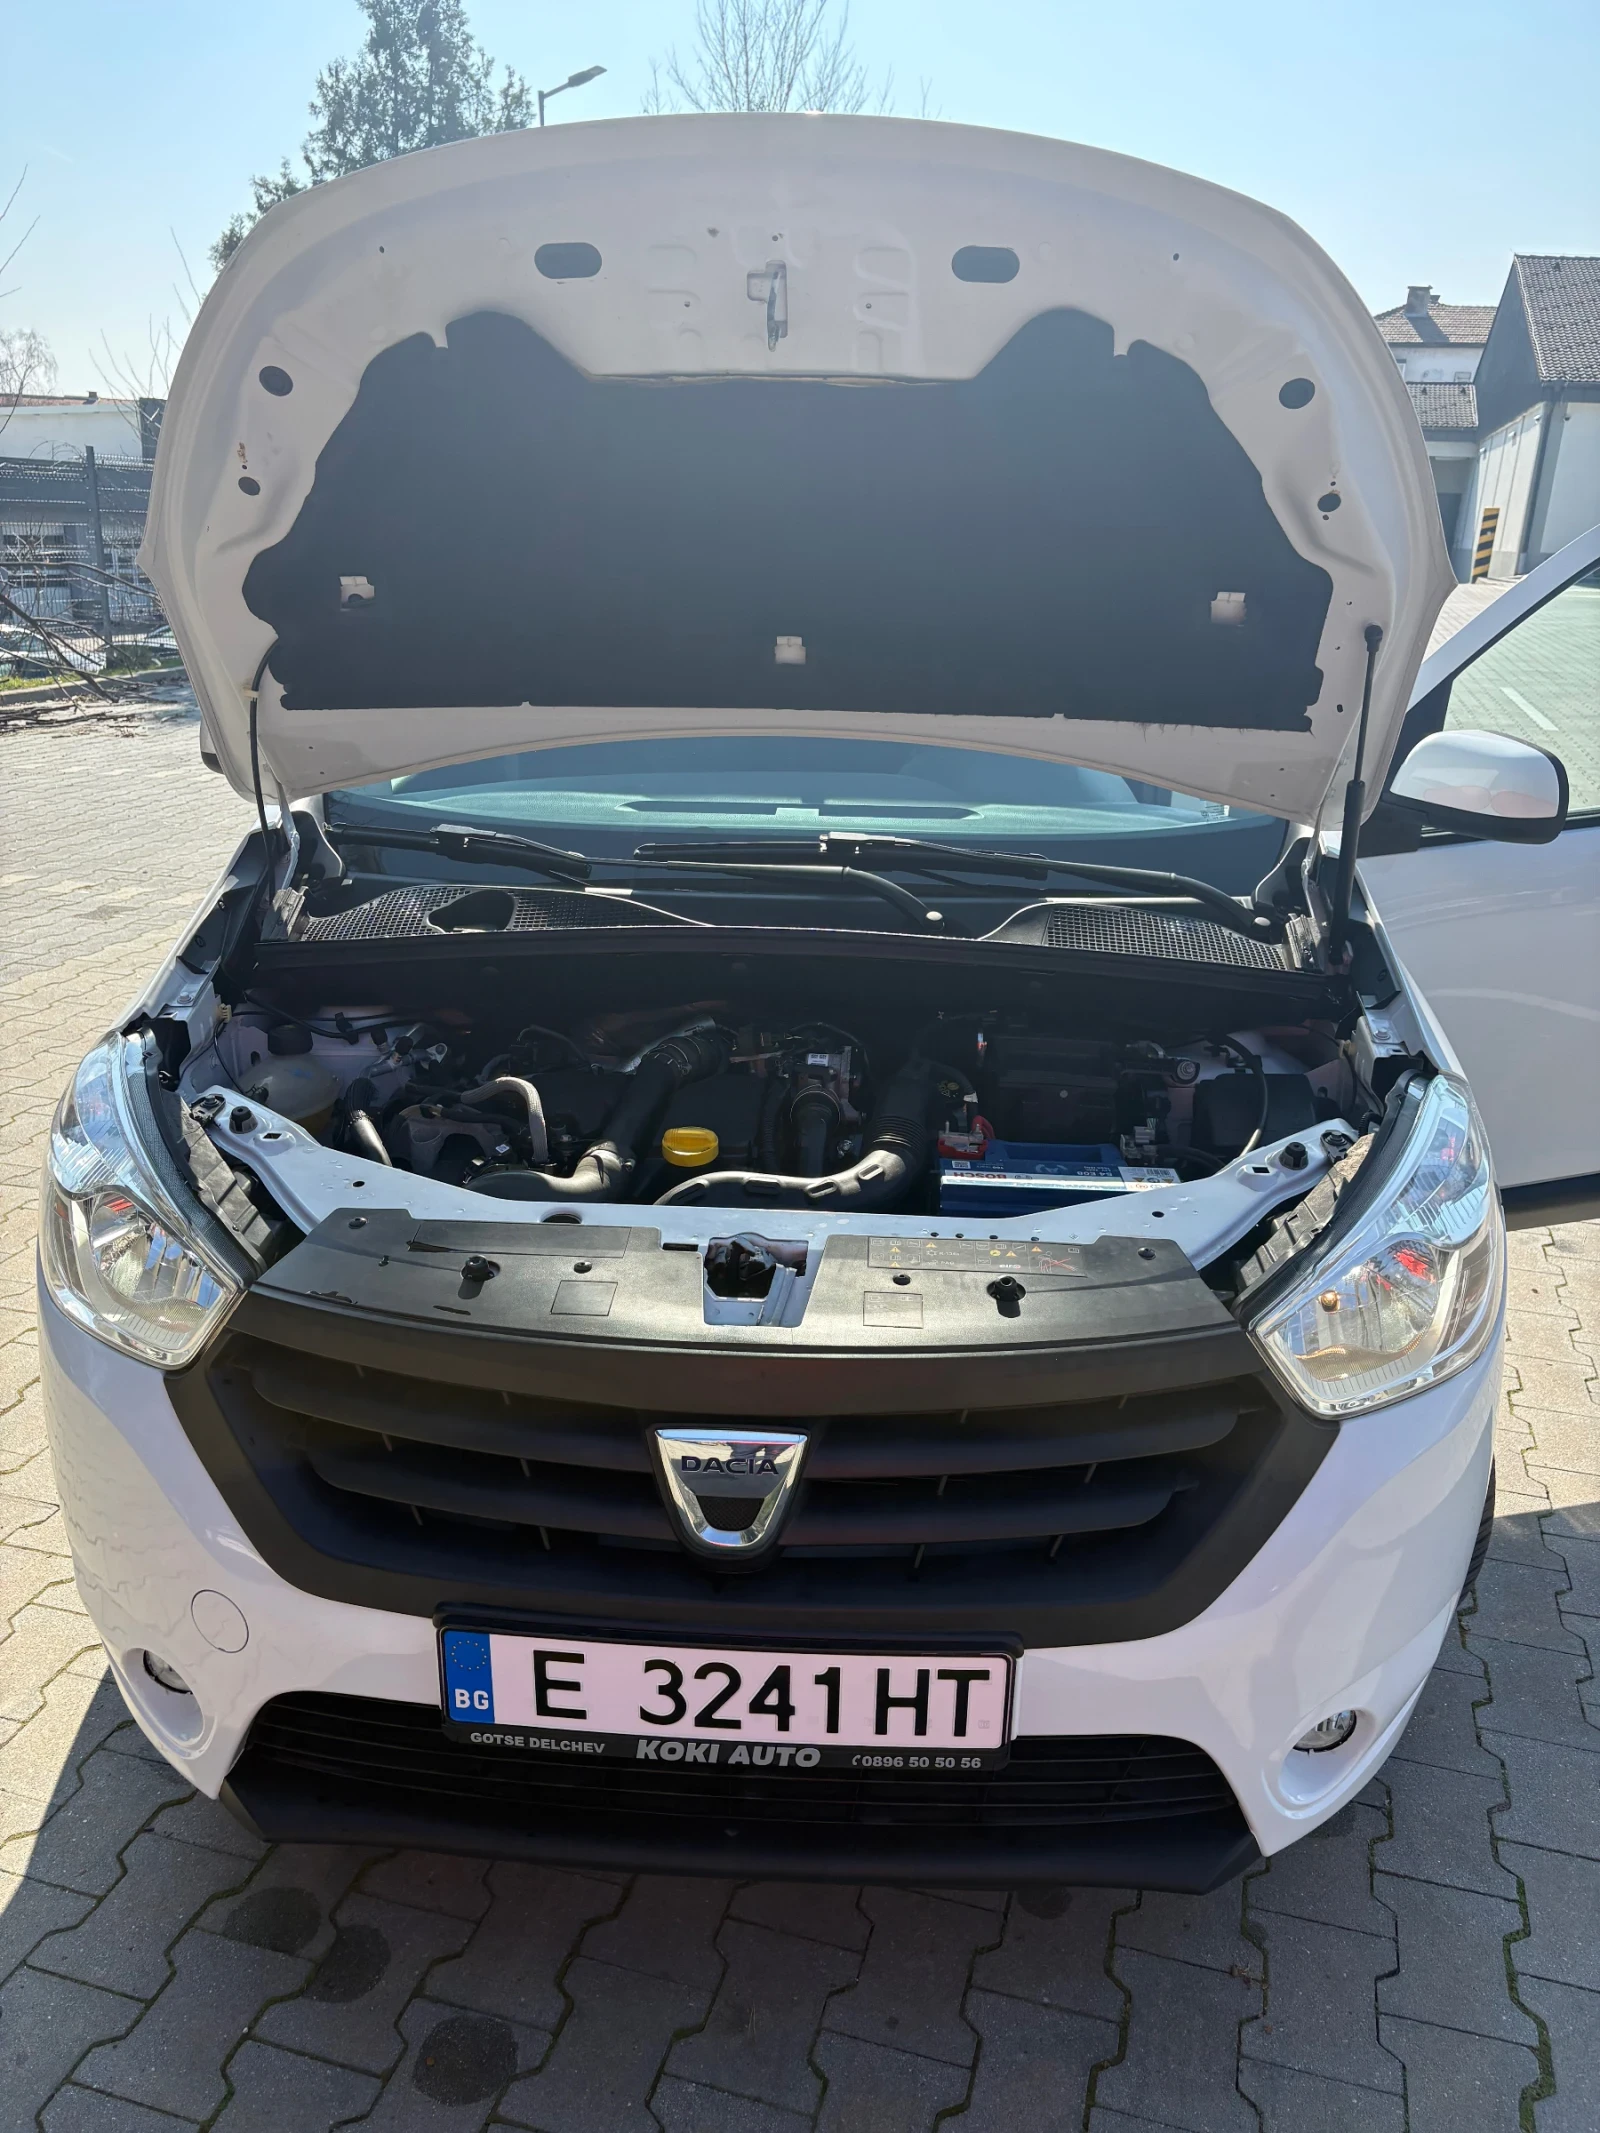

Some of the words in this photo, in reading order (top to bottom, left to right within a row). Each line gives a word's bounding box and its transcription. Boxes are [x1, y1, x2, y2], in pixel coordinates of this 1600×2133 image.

[953, 1171, 1007, 1180] BOSCH
[681, 1455, 779, 1475] DACIA
[454, 1688, 489, 1710] BG
[533, 1649, 588, 1720] E
[639, 1658, 841, 1734] 3241
[874, 1667, 991, 1737] HT
[470, 1732, 525, 1748] GOTSE
[529, 1737, 606, 1754] DELCHEV
[635, 1739, 720, 1764] KOKI
[728, 1745, 821, 1767] AUTO
[861, 1755, 904, 1768] 0896
[908, 1756, 930, 1768] 50
[934, 1757, 956, 1769] 50
[960, 1757, 982, 1769] 56
